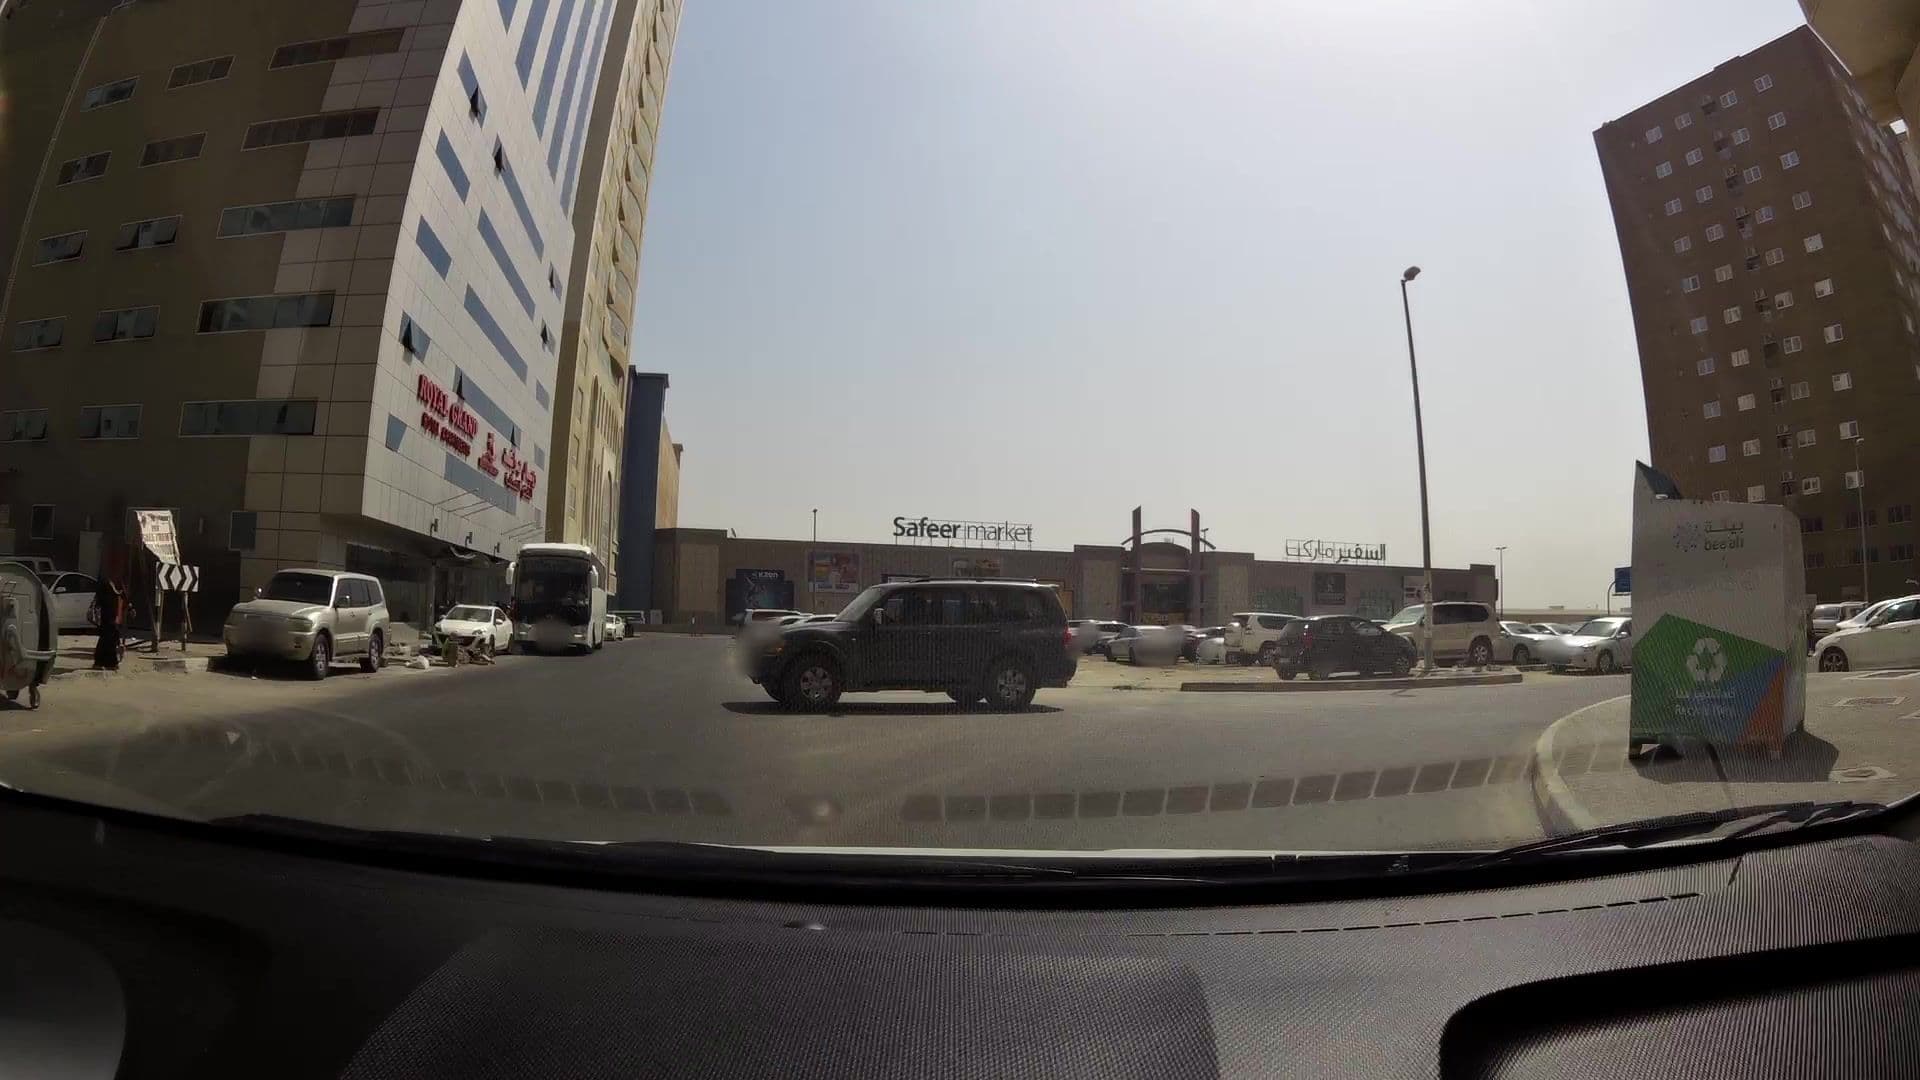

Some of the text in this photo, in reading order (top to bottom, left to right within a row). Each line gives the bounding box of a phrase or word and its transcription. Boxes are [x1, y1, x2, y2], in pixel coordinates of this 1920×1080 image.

[417, 374, 449, 418] ROYAL
[893, 516, 1034, 543] Safeer market
